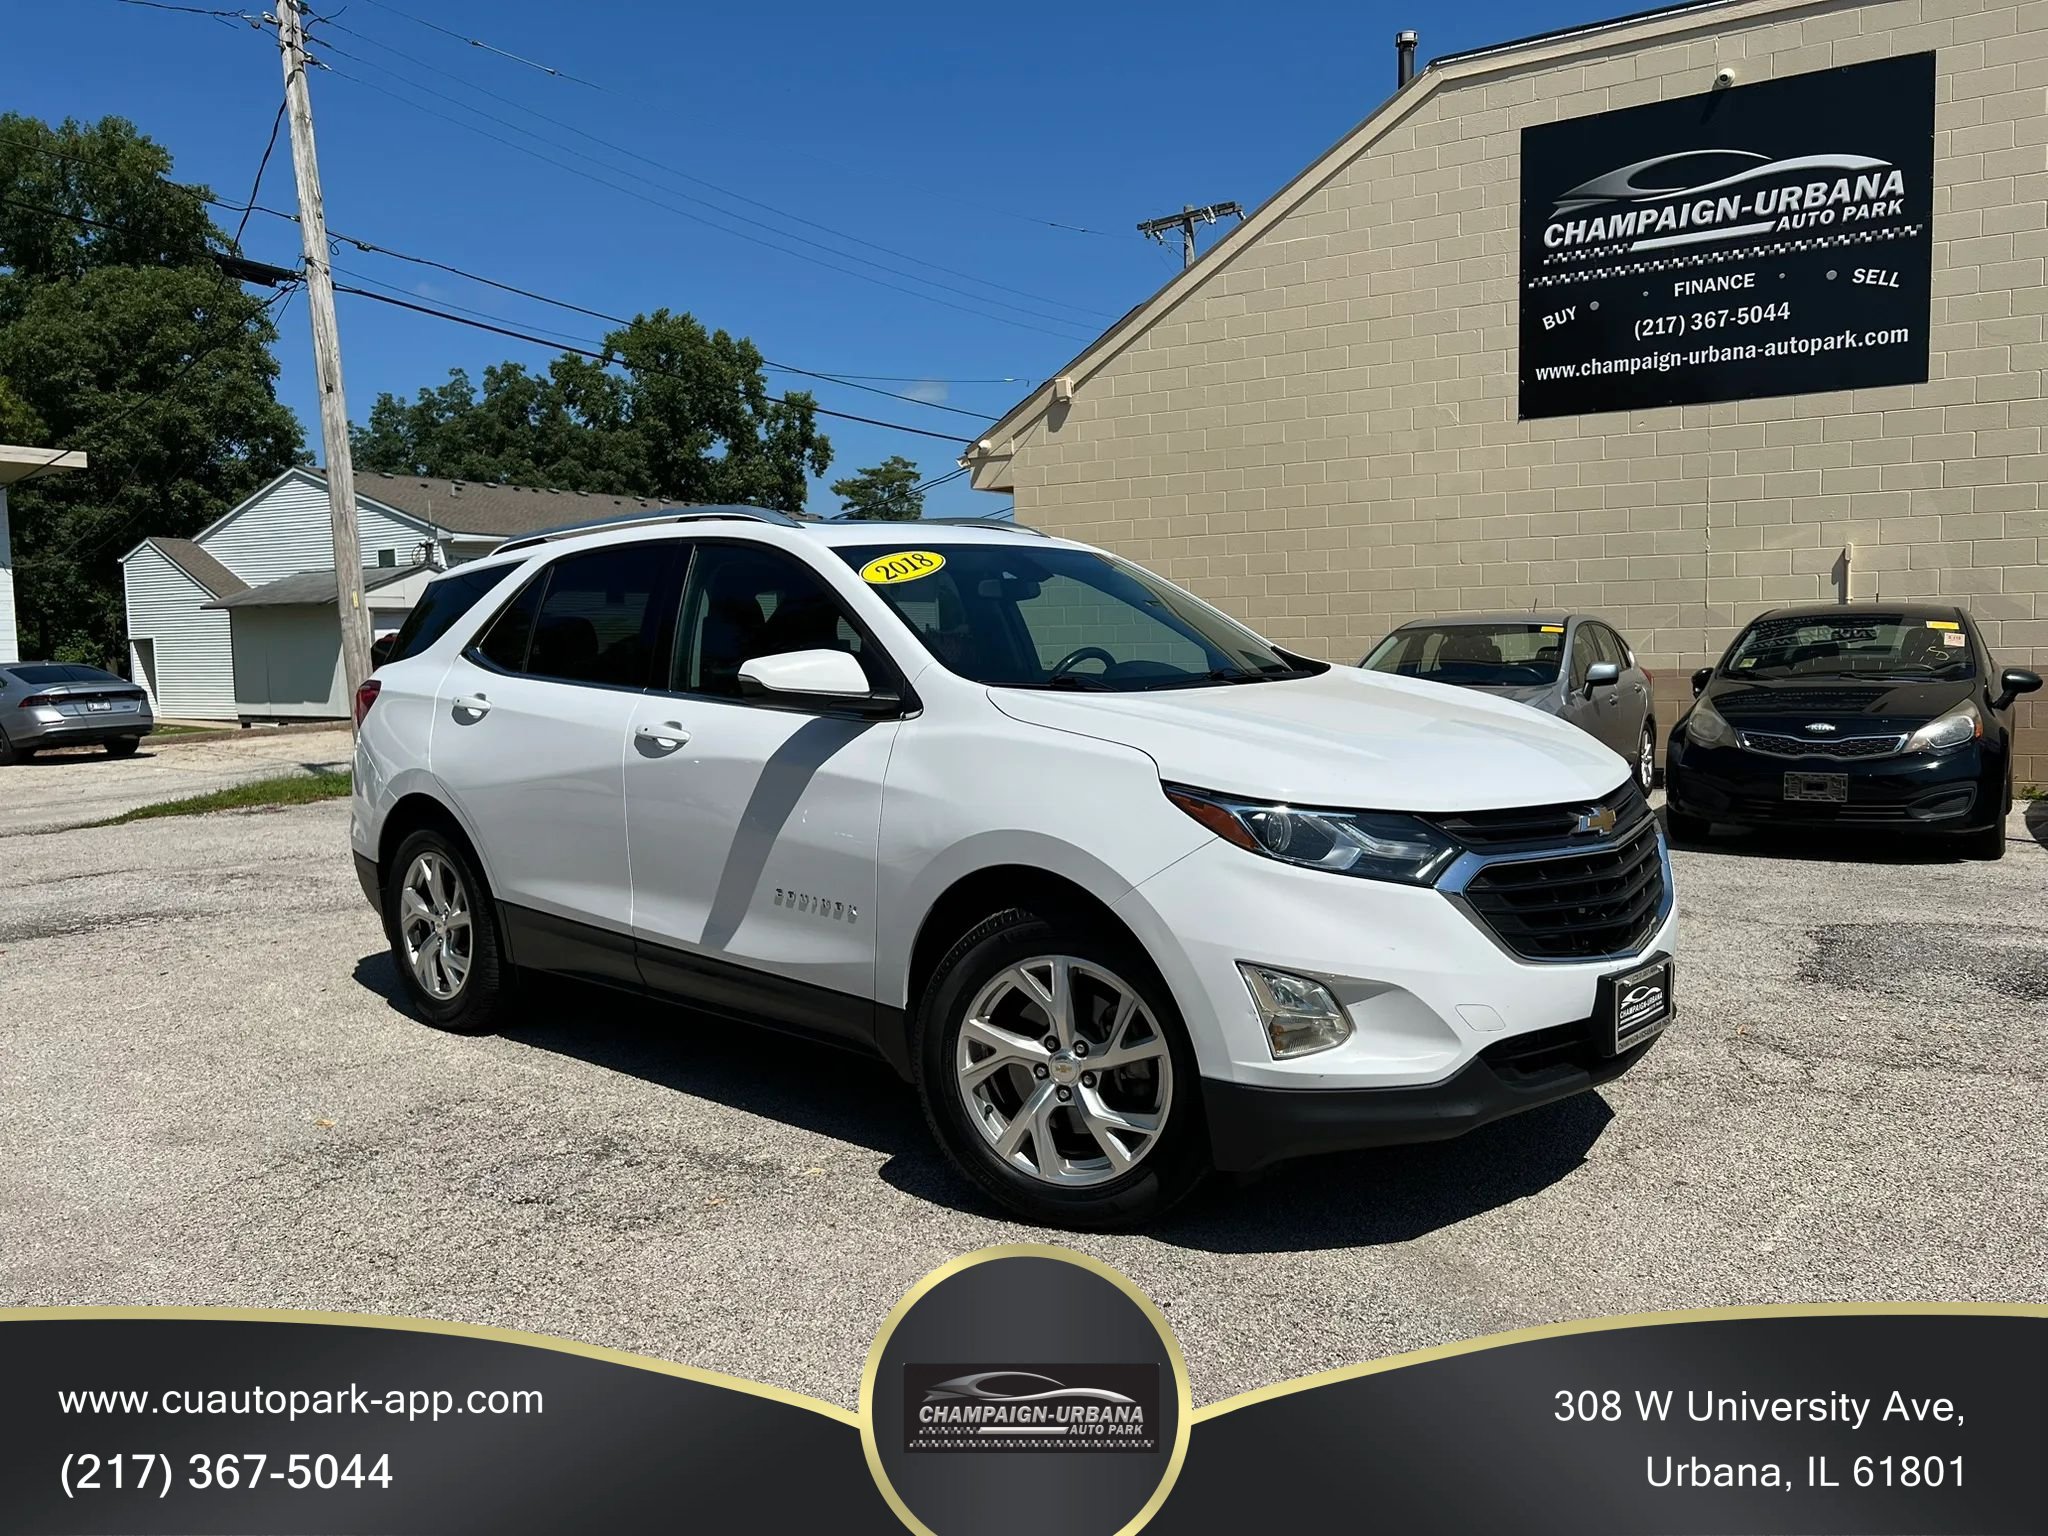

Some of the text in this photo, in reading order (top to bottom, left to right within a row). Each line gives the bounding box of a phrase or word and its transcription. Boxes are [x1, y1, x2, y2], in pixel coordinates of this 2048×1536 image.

[1543, 170, 1905, 248] CHAMPAIGN-URBANA
[1776, 199, 1905, 232] AUTO PARK
[1542, 268, 1900, 331] BUY FINANCE SELL
[1634, 302, 1791, 341] (217) 367-5044
[1535, 328, 1909, 381] www.champaign-urbana-autopark.com
[875, 553, 934, 580] 2018
